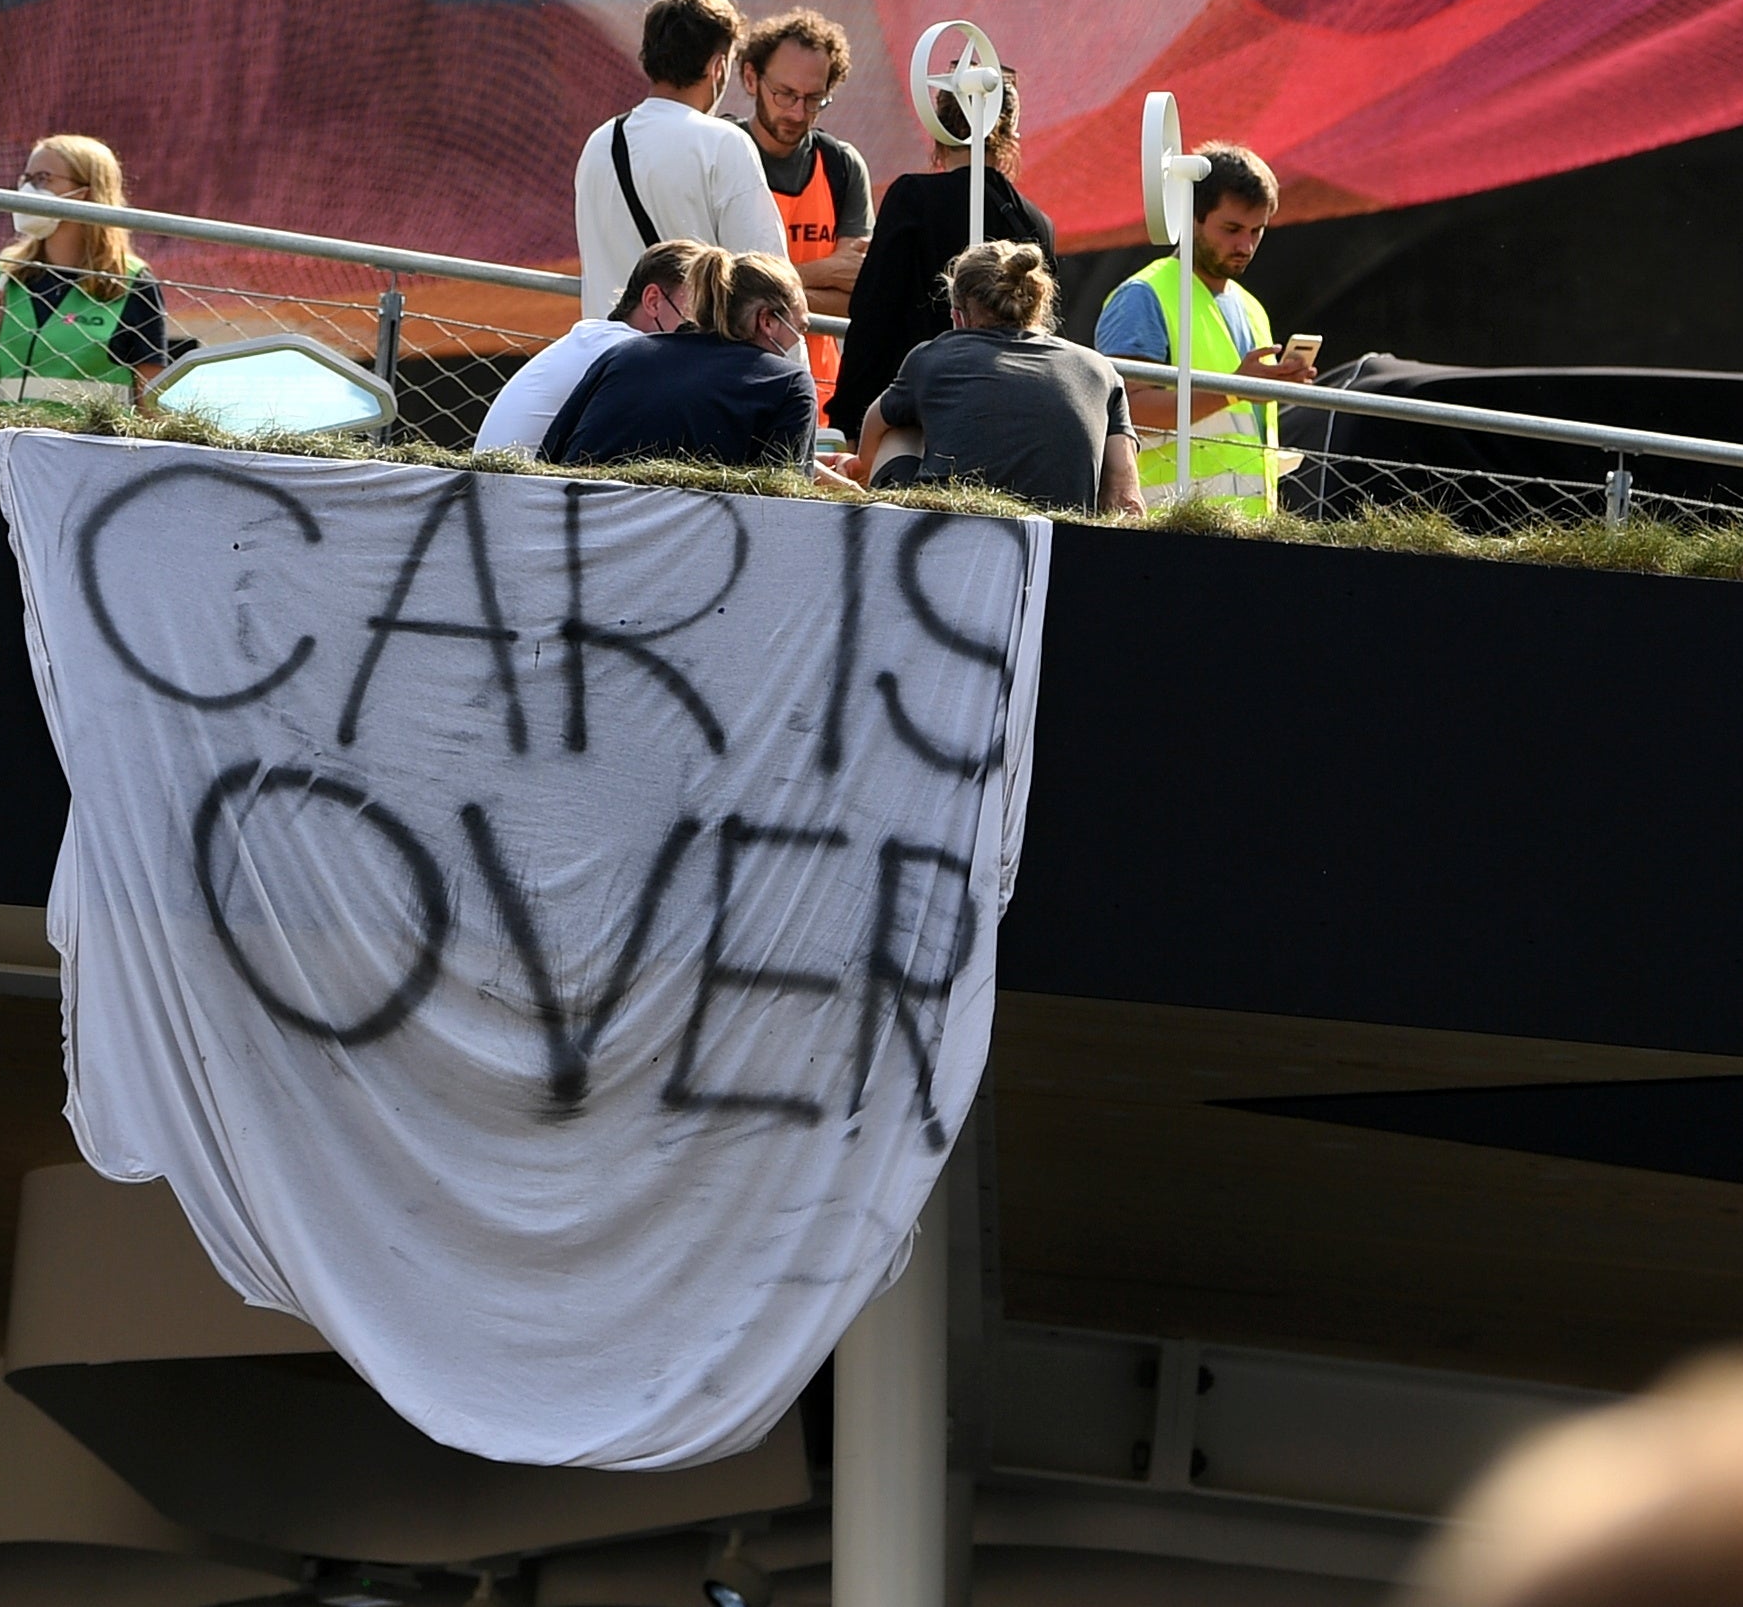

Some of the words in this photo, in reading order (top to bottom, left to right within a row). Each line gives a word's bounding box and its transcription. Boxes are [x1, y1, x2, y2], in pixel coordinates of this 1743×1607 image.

[73, 464, 752, 754] CAR
[818, 504, 1028, 780] IS
[194, 756, 978, 1151] OVER
